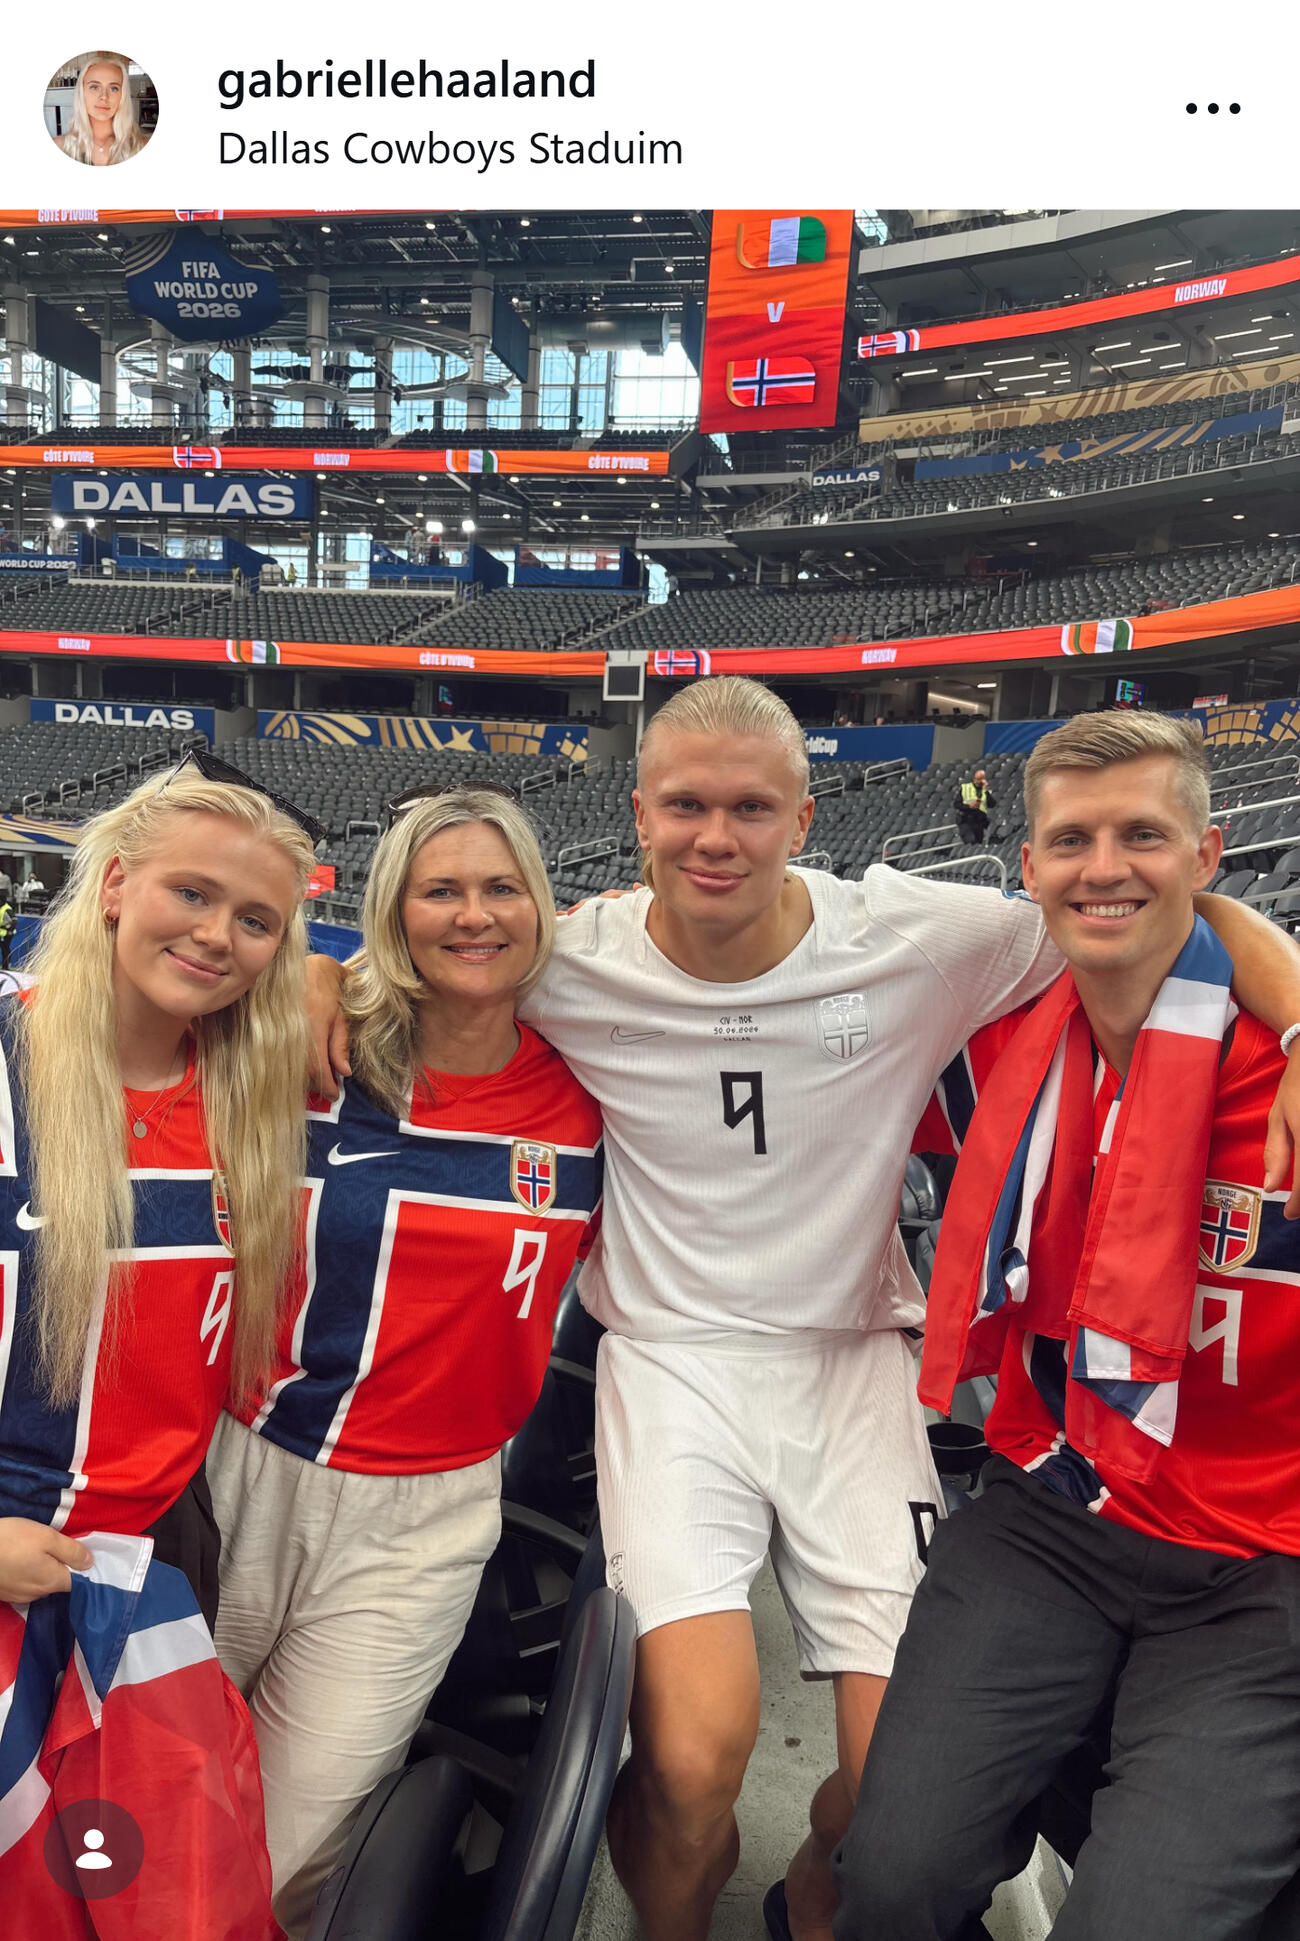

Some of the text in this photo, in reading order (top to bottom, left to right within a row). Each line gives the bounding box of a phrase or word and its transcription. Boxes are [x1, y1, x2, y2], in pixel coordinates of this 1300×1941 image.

[182, 261, 221, 279] FIFA
[153, 281, 258, 299] WORLD CUP
[1174, 279, 1227, 303] NORWAY
[177, 302, 242, 318] 2026
[812, 470, 881, 487] DALLAS
[72, 480, 296, 516] DALLAS
[28, 560, 46, 569] CUP
[54, 703, 195, 731] DALLAS
[720, 1070, 767, 1155] 9
[1217, 1187, 1237, 1199] NORGE
[502, 1227, 548, 1319] 9
[1188, 1283, 1243, 1387] 9
